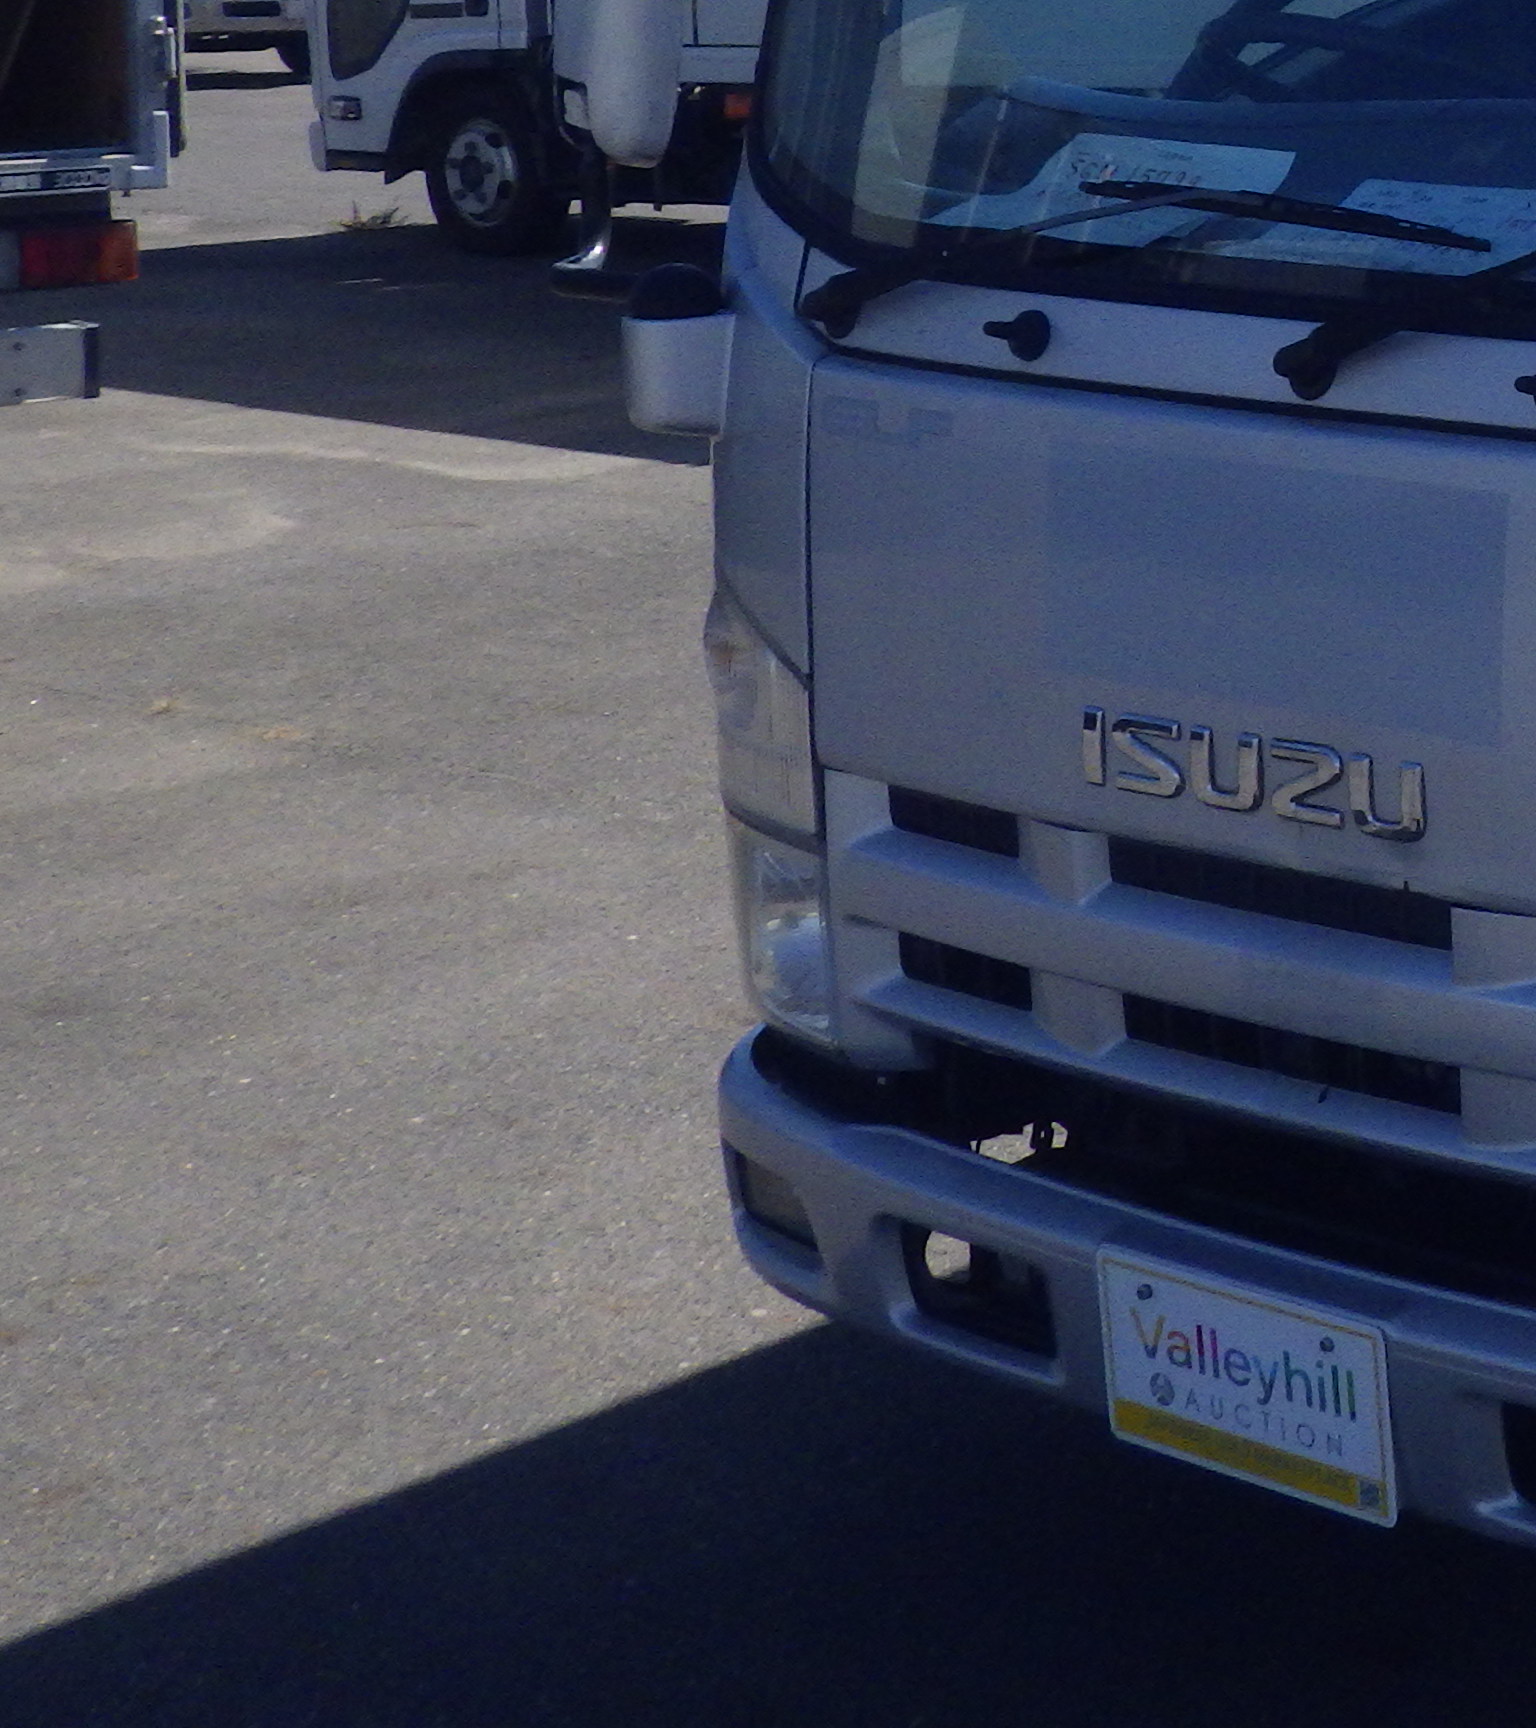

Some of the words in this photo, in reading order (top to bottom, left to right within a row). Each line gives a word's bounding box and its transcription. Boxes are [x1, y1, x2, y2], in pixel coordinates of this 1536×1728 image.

[1083, 705, 1428, 843] ISUZU
[1129, 1306, 1357, 1423] Valleyhill
[1185, 1387, 1344, 1457] AUCTION
